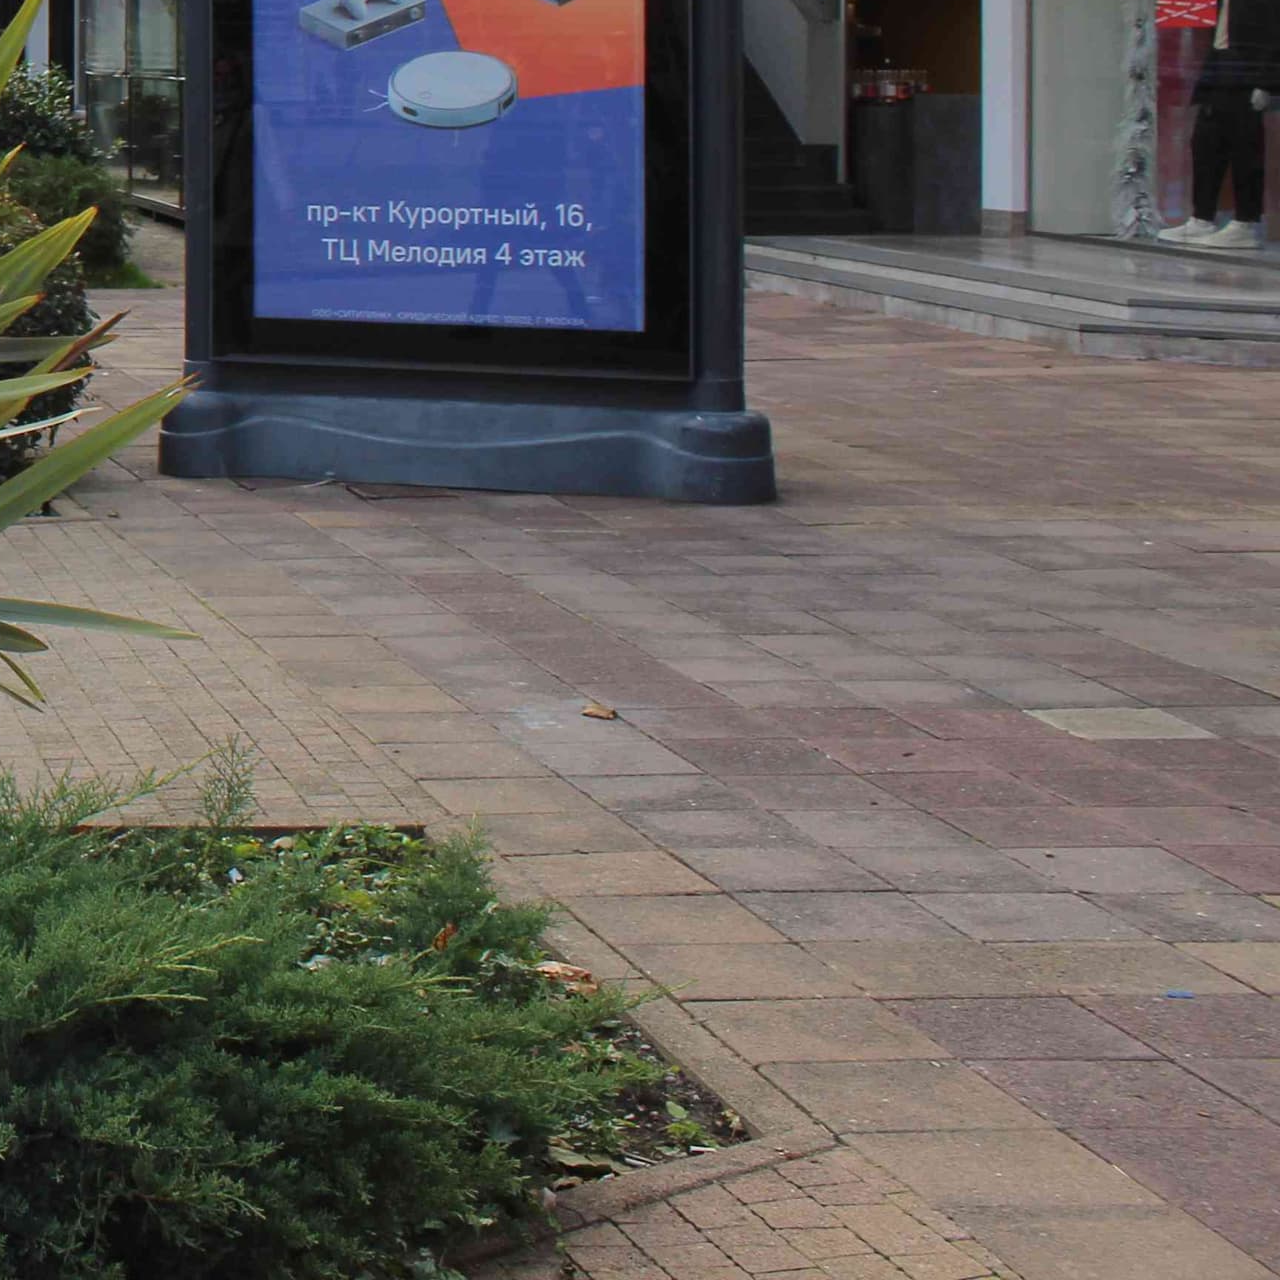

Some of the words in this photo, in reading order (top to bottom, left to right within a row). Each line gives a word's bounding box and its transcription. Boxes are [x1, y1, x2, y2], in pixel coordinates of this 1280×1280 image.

[307, 204, 381, 227] пр-кт
[389, 201, 547, 230] Курортный,
[556, 204, 593, 231] 16,
[322, 238, 360, 265] ТЦ
[367, 239, 487, 267] Мелодия
[495, 243, 512, 265] 4
[519, 250, 586, 267] этаж
